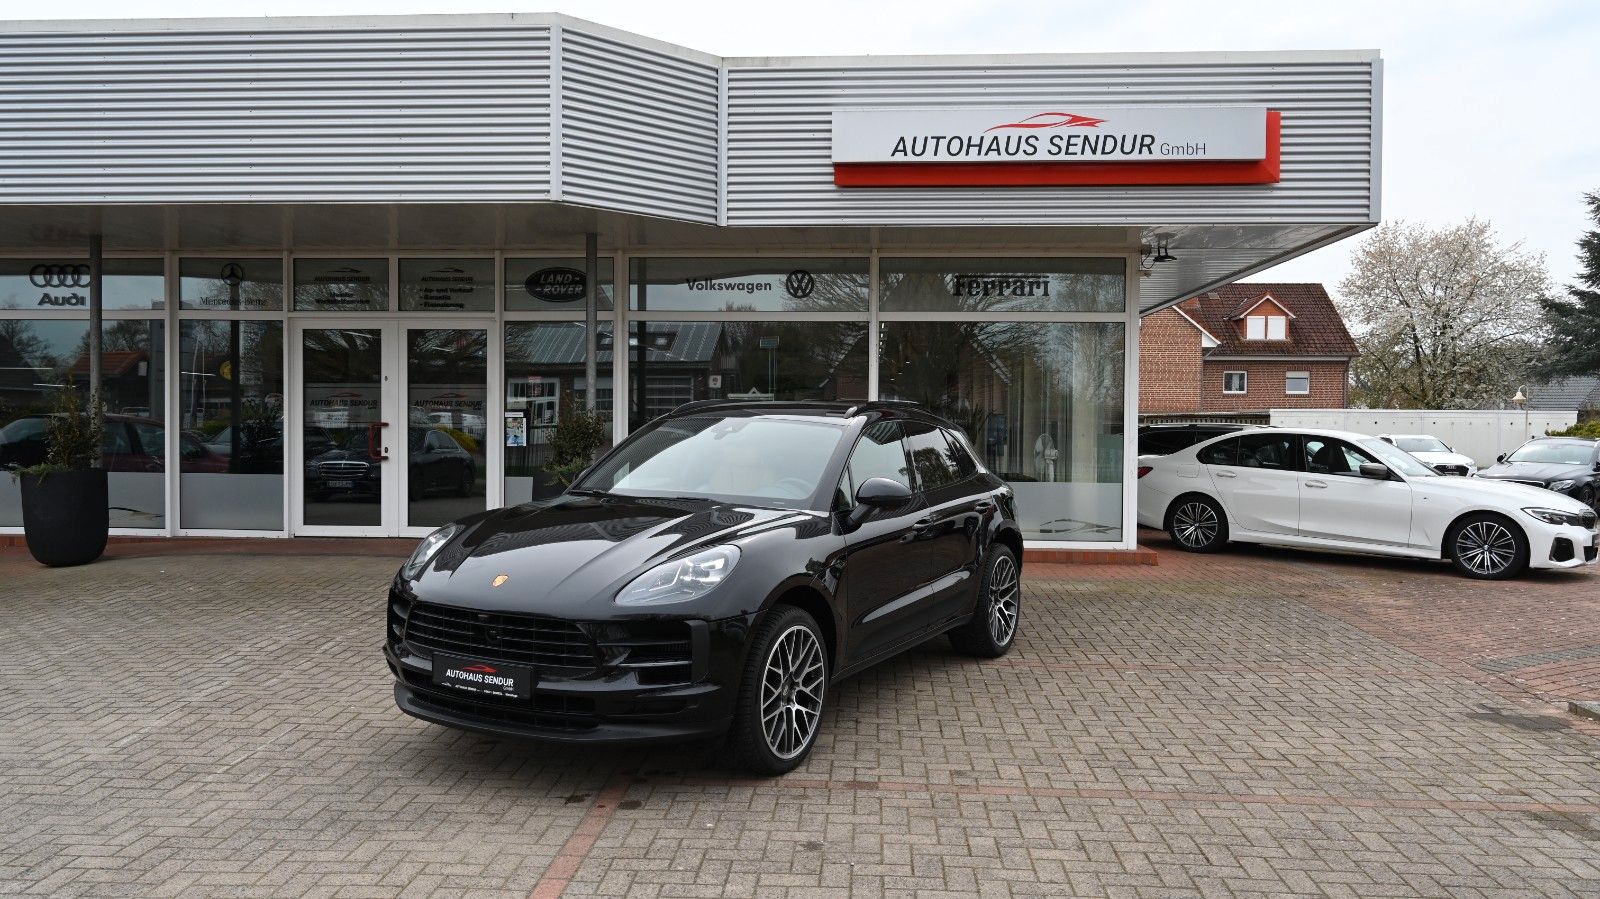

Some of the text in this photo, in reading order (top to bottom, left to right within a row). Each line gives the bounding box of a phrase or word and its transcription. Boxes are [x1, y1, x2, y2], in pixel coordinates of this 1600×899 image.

[891, 134, 1207, 158] AUTOHAUS SENDUR GmbH
[686, 278, 772, 294] Volkswagen
[953, 274, 1050, 297] Ferrari
[37, 292, 87, 307] Audi
[310, 399, 378, 407] AUTOHAUS SENDUR
[454, 400, 483, 408] SENDUR
[445, 668, 514, 687] AUTOHAUS SENDUR
